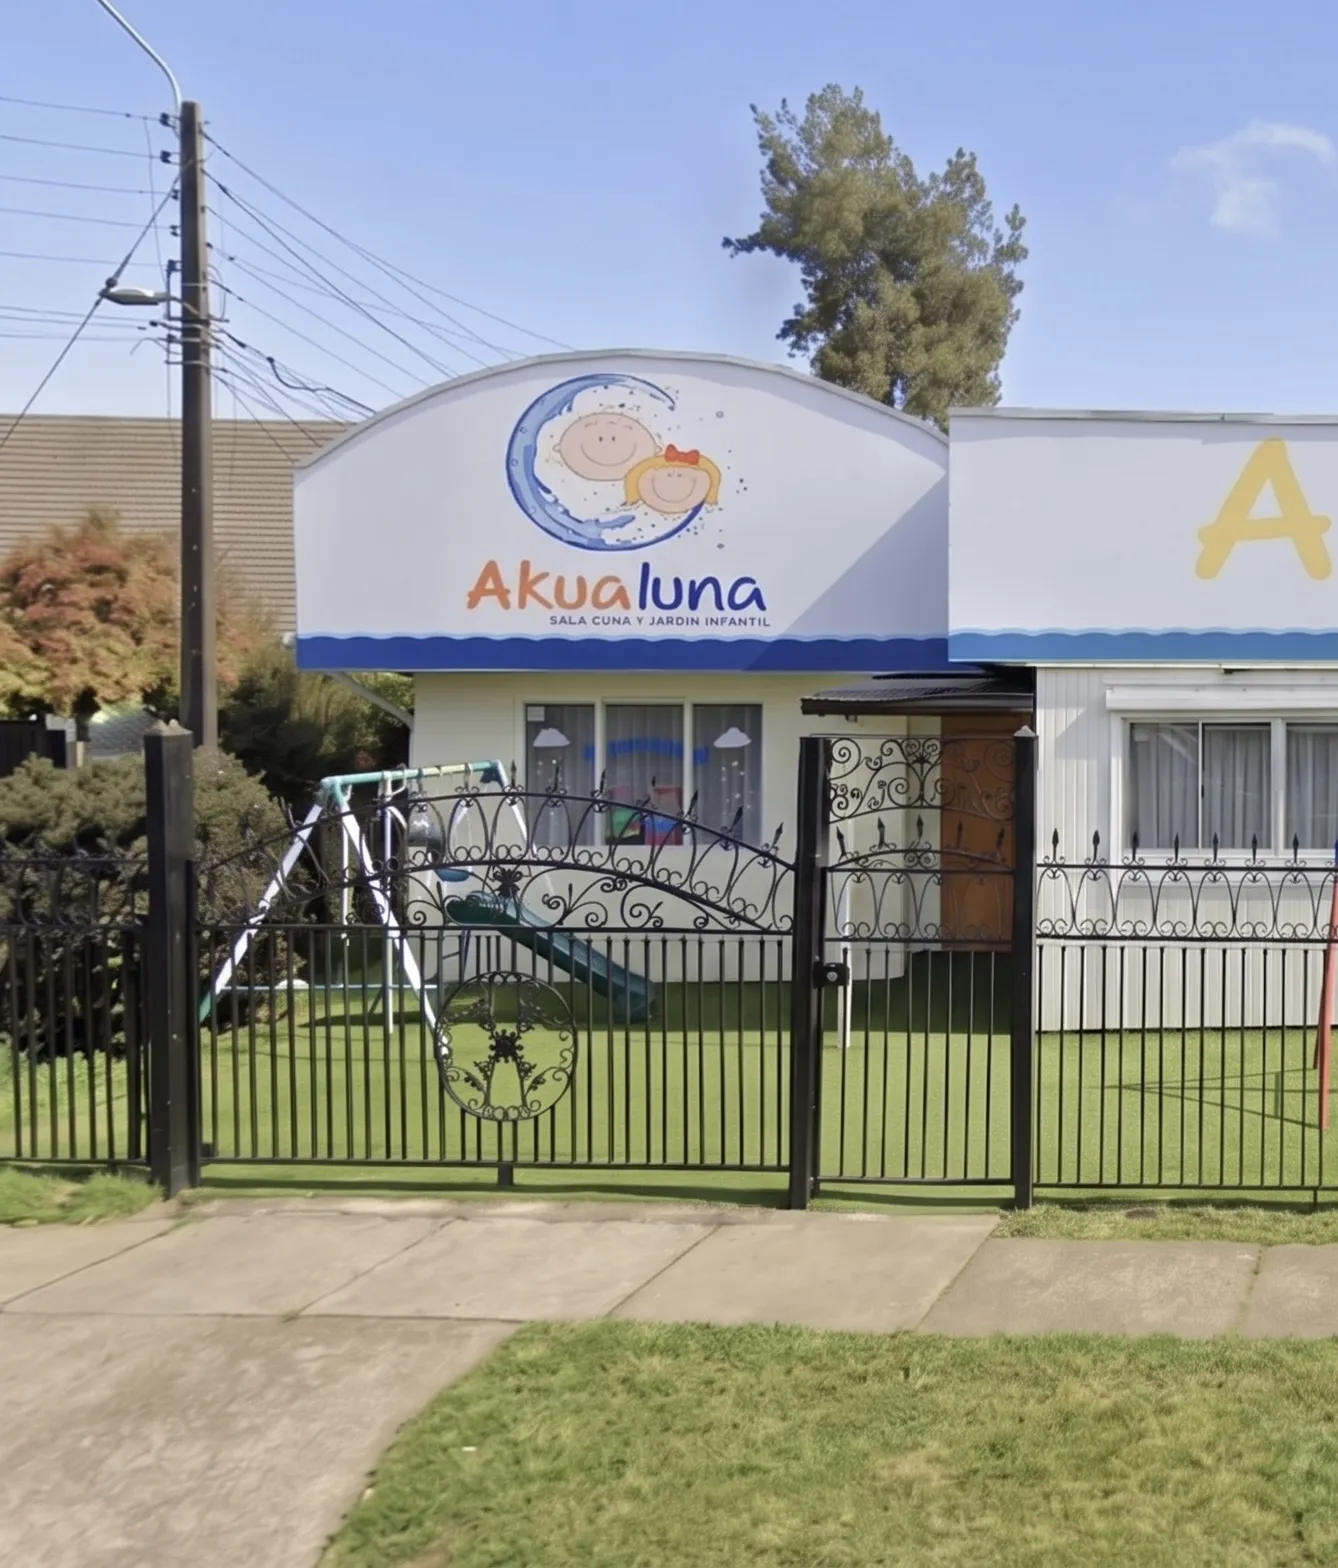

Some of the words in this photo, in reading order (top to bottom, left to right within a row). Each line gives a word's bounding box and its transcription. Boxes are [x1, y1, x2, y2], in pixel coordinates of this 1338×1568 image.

[466, 559, 767, 612] Akualuna
[549, 615, 587, 626] SALA
[592, 616, 631, 626] CUNA
[636, 616, 644, 626] Y
[649, 616, 700, 627] JARDIN
[705, 616, 771, 628] INFANTIL
